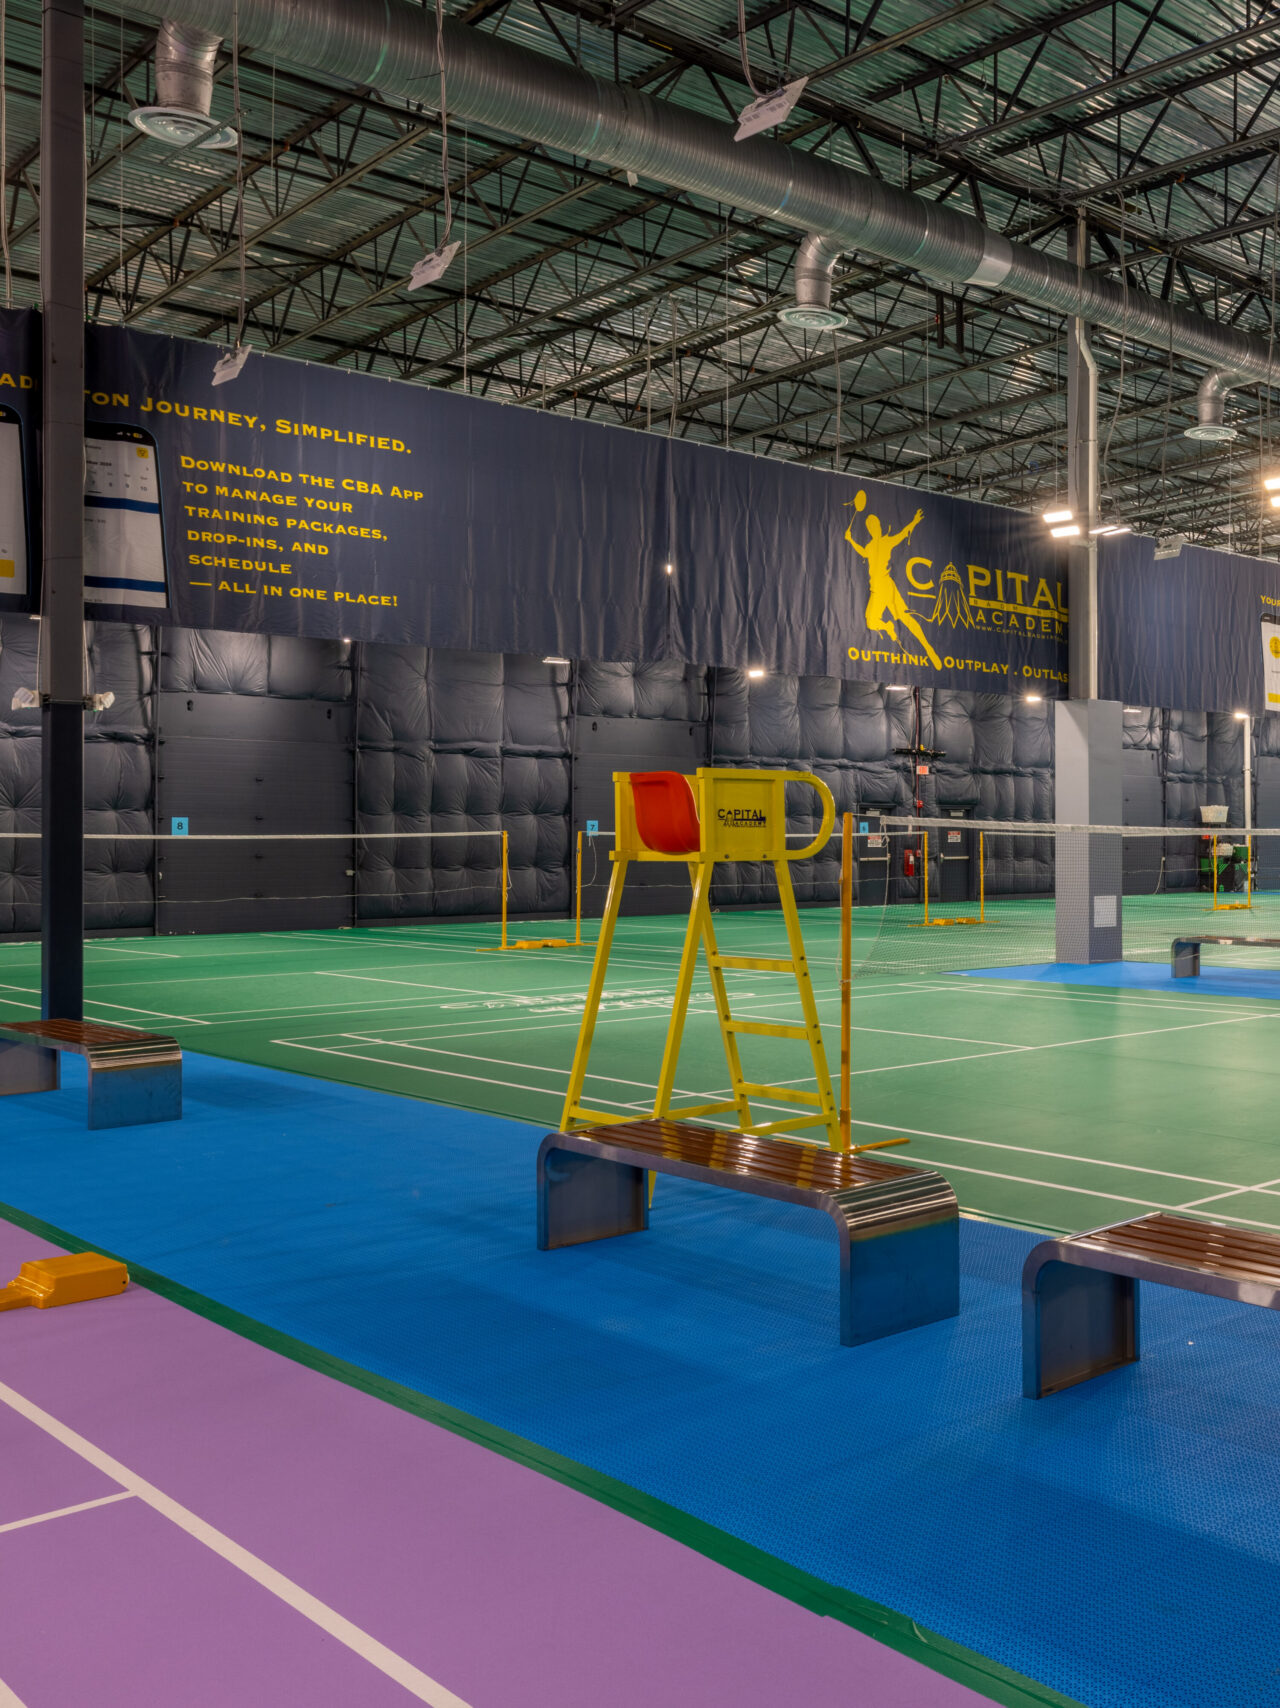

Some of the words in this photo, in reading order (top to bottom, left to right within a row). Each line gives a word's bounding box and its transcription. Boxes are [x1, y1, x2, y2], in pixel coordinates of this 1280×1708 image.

[141, 398, 266, 432] JOURNEY,
[276, 419, 411, 454] SIMPLIFIED.
[180, 456, 292, 483] DOWNLOAD
[299, 474, 335, 488] THE
[342, 479, 383, 495] CBA
[391, 486, 424, 501] APP
[182, 481, 208, 494] TO
[216, 485, 298, 506] MANAGE
[304, 497, 352, 512] YOUR
[184, 505, 279, 526] TRAINING
[286, 518, 387, 541] PACKAGES,
[187, 530, 283, 552] DROP-INS,
[292, 542, 329, 555] AND
[189, 555, 292, 574] SCHEDULE
[218, 581, 256, 594] ALL
[264, 585, 282, 597] IN
[289, 587, 328, 600] ONE
[334, 592, 398, 607] PLACE!
[976, 609, 1064, 635] ACADEM
[847, 647, 929, 667] OUTTHINK
[944, 656, 1009, 675] OUTPLAY
[177, 821, 183, 831] 8
